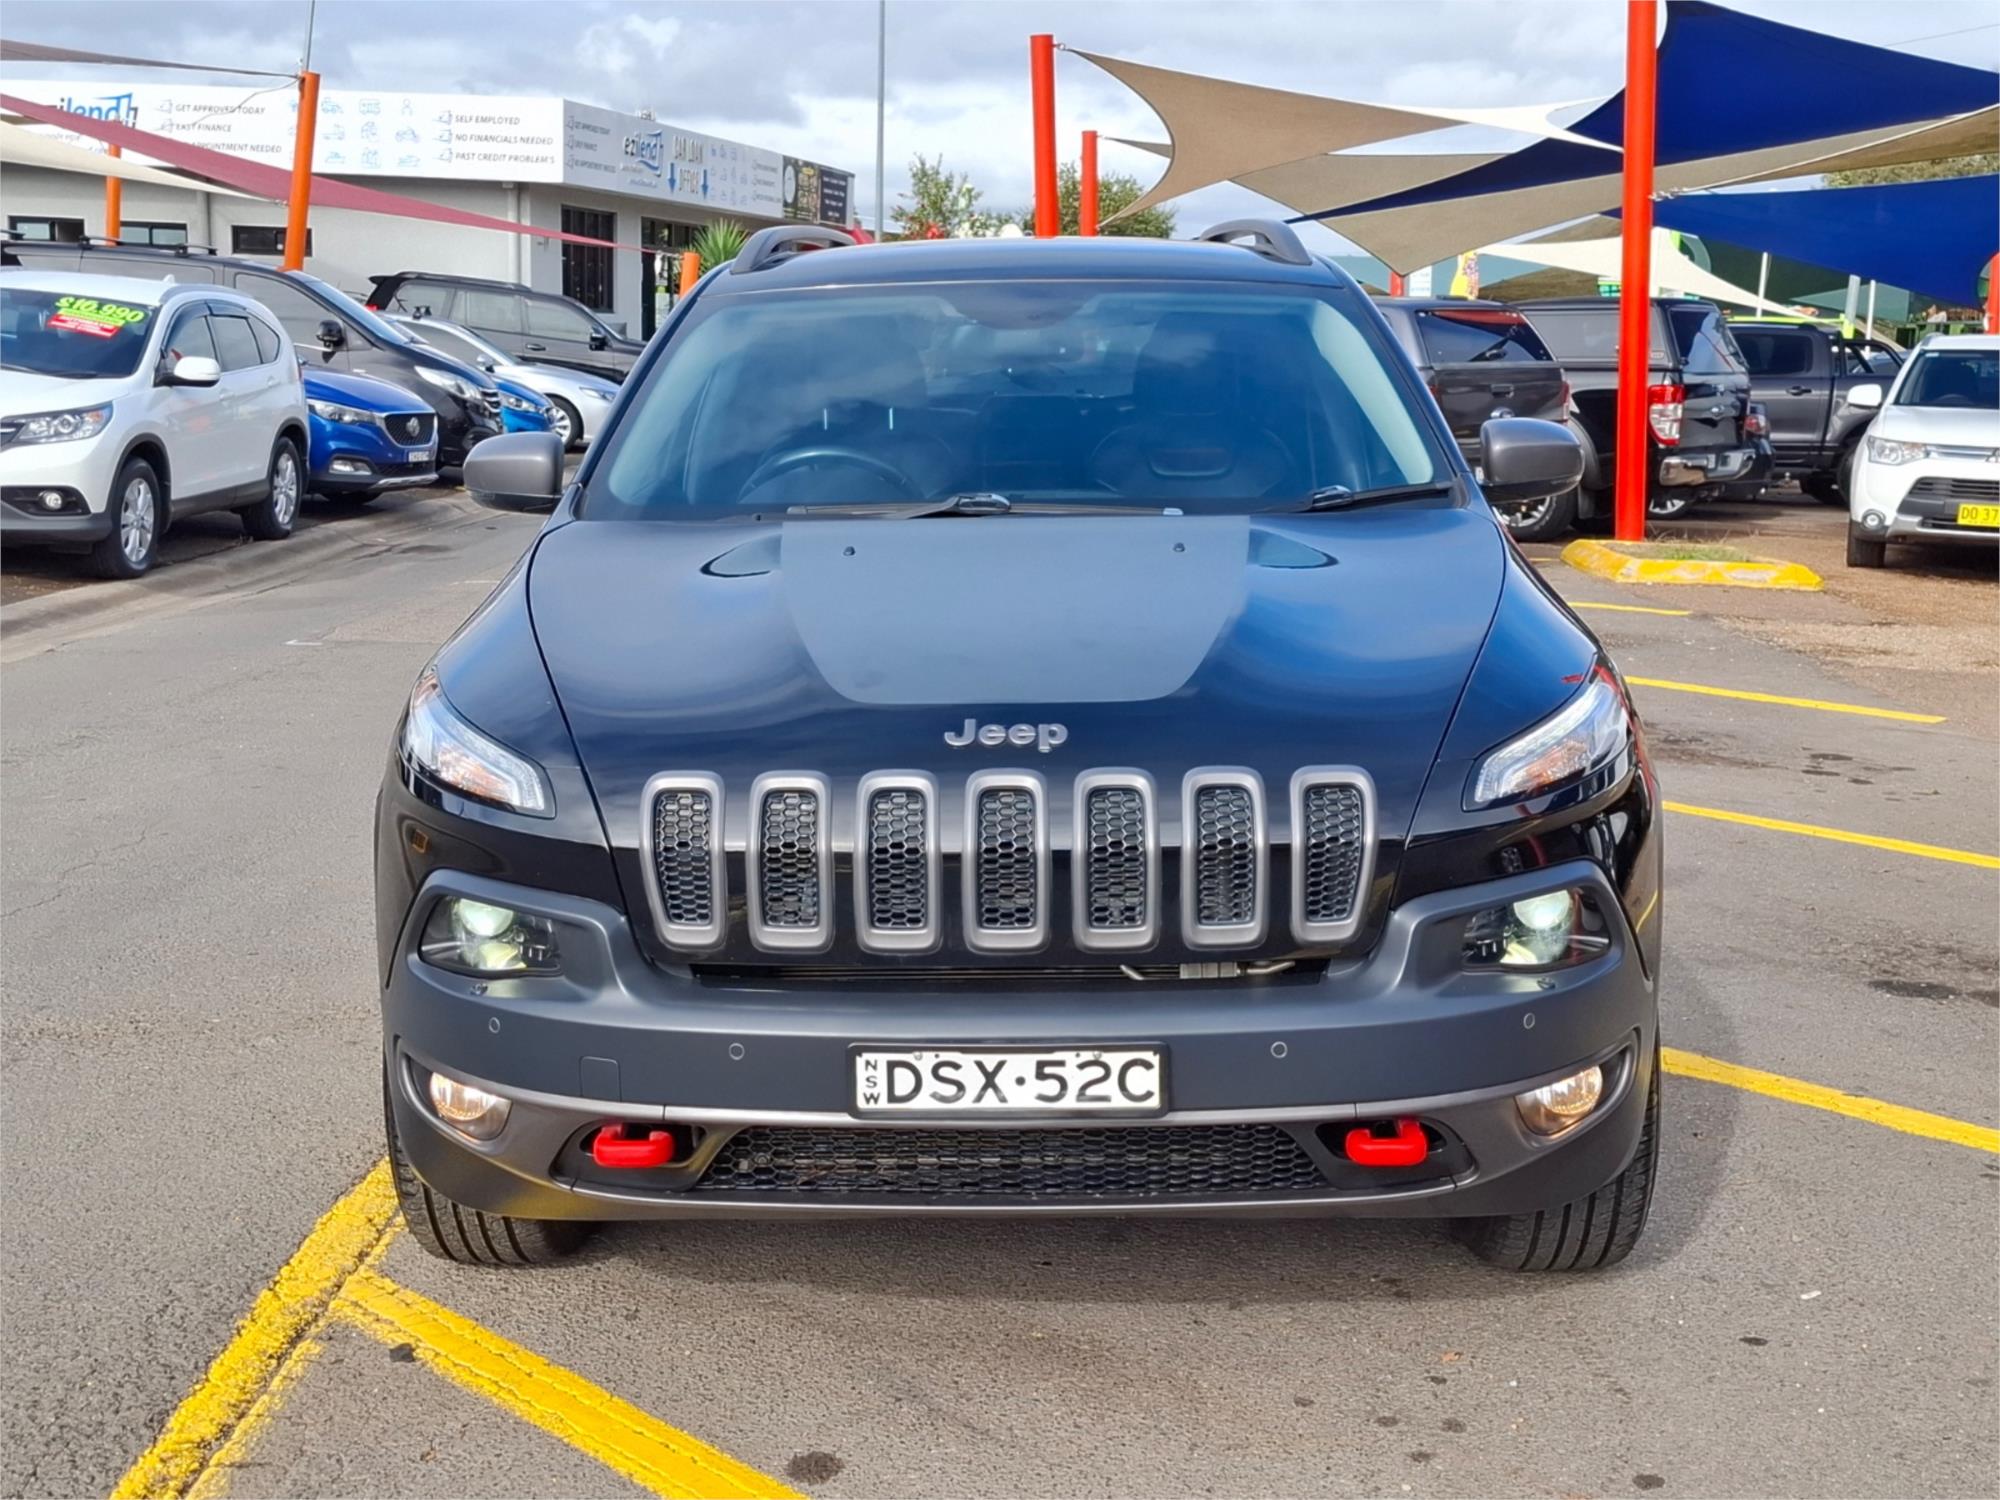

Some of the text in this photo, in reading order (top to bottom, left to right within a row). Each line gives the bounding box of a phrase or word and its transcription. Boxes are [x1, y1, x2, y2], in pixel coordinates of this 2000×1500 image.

[175, 104, 191, 113] GET
[455, 114, 521, 126] SELF EMPLOYED
[198, 123, 232, 133] FINANCE
[455, 133, 554, 146] NO FINANCIALS NEEDED
[249, 144, 282, 154] NEEDED
[455, 152, 476, 161] PAST
[477, 152, 507, 162] CREDIT
[944, 718, 1068, 753] Jeep
[863, 1059, 881, 1105] NSW
